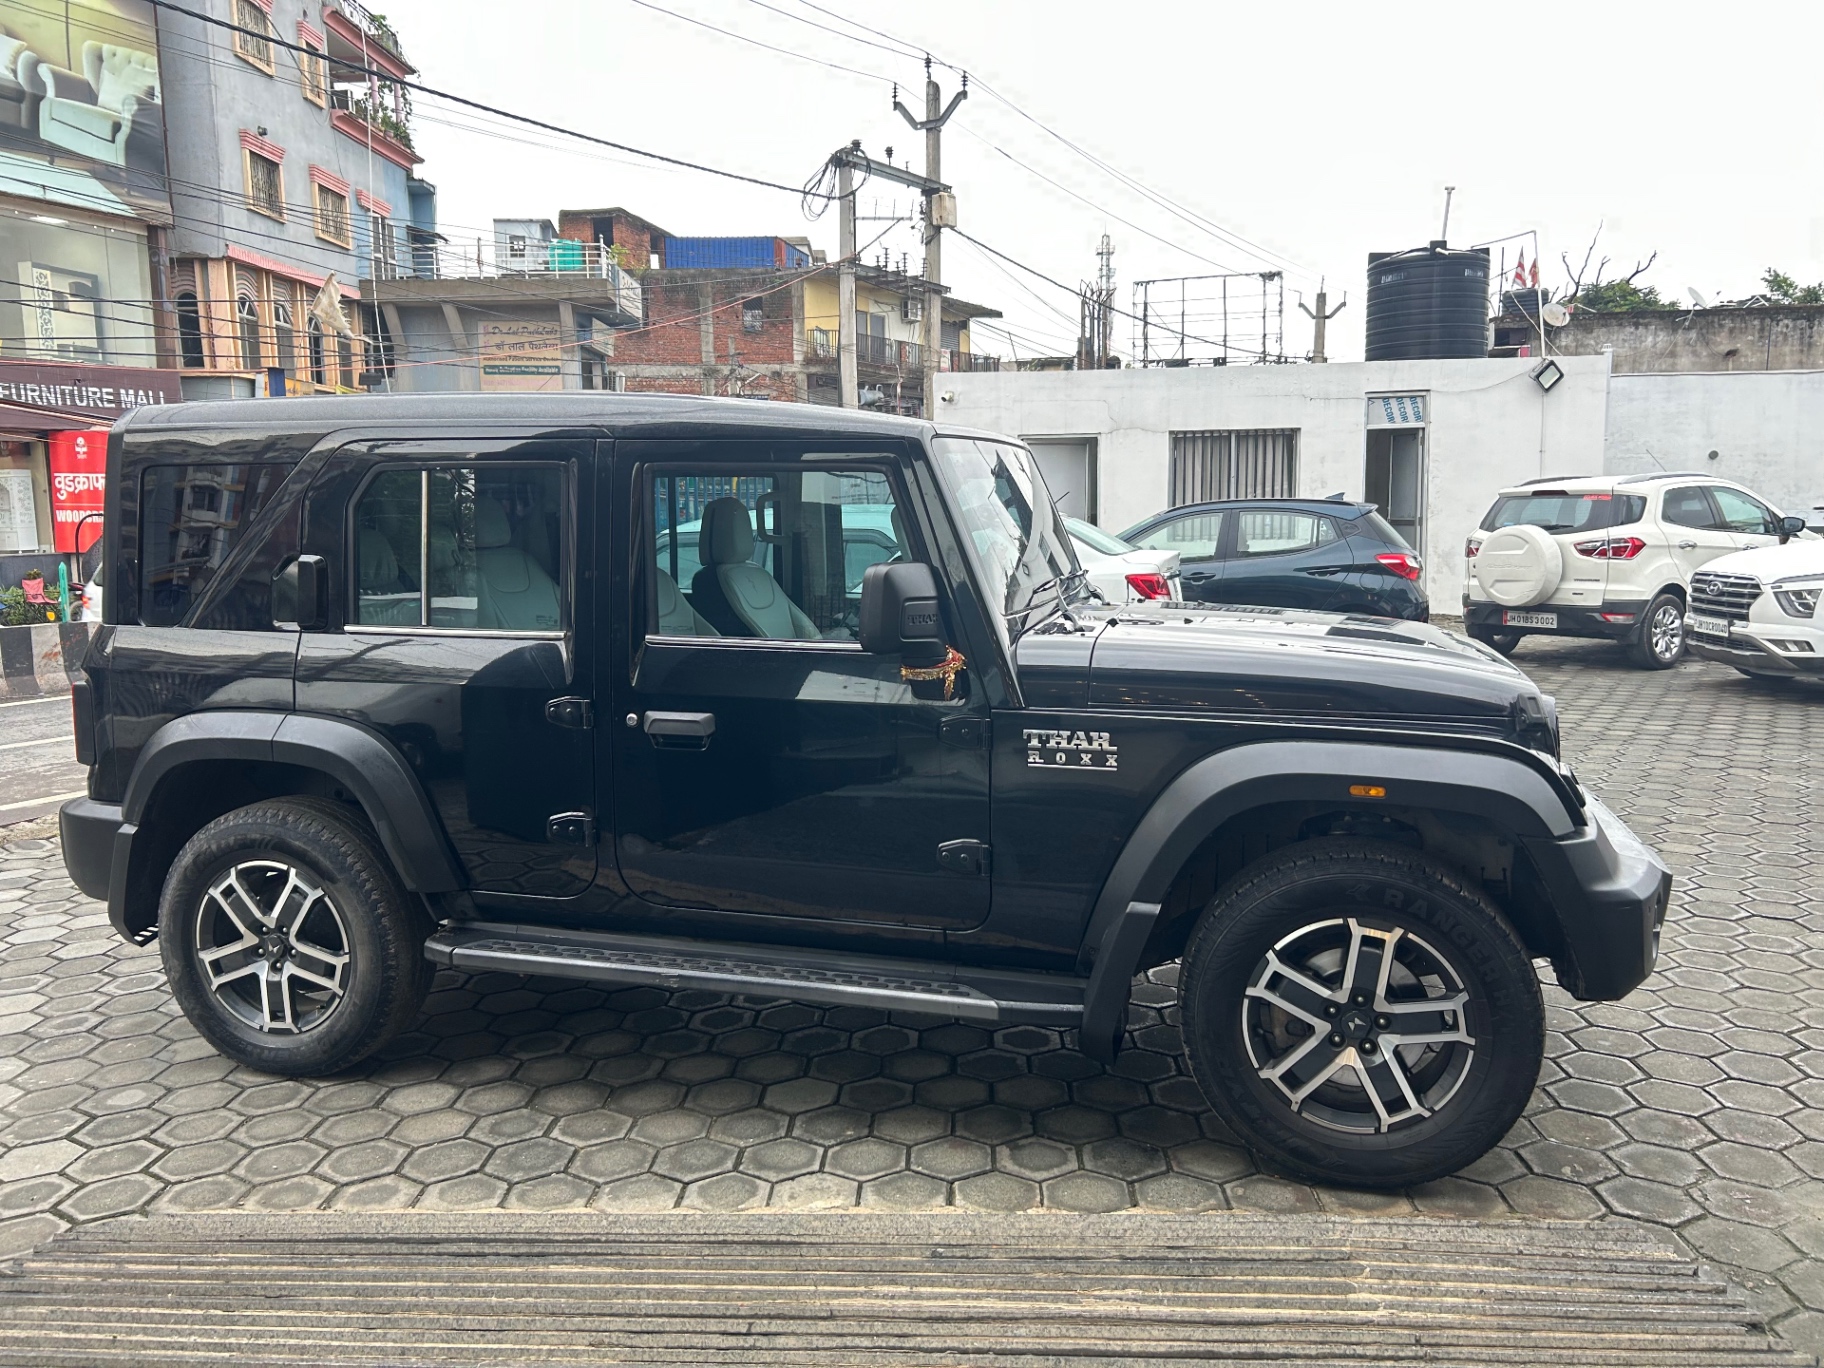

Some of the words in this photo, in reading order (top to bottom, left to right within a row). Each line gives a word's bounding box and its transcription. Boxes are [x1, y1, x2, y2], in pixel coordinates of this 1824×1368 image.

[0, 382, 116, 408] FURNITURE
[1022, 728, 1118, 752] THAR
[1027, 750, 1118, 767] ROXX
[1383, 887, 1502, 983] RANGER
